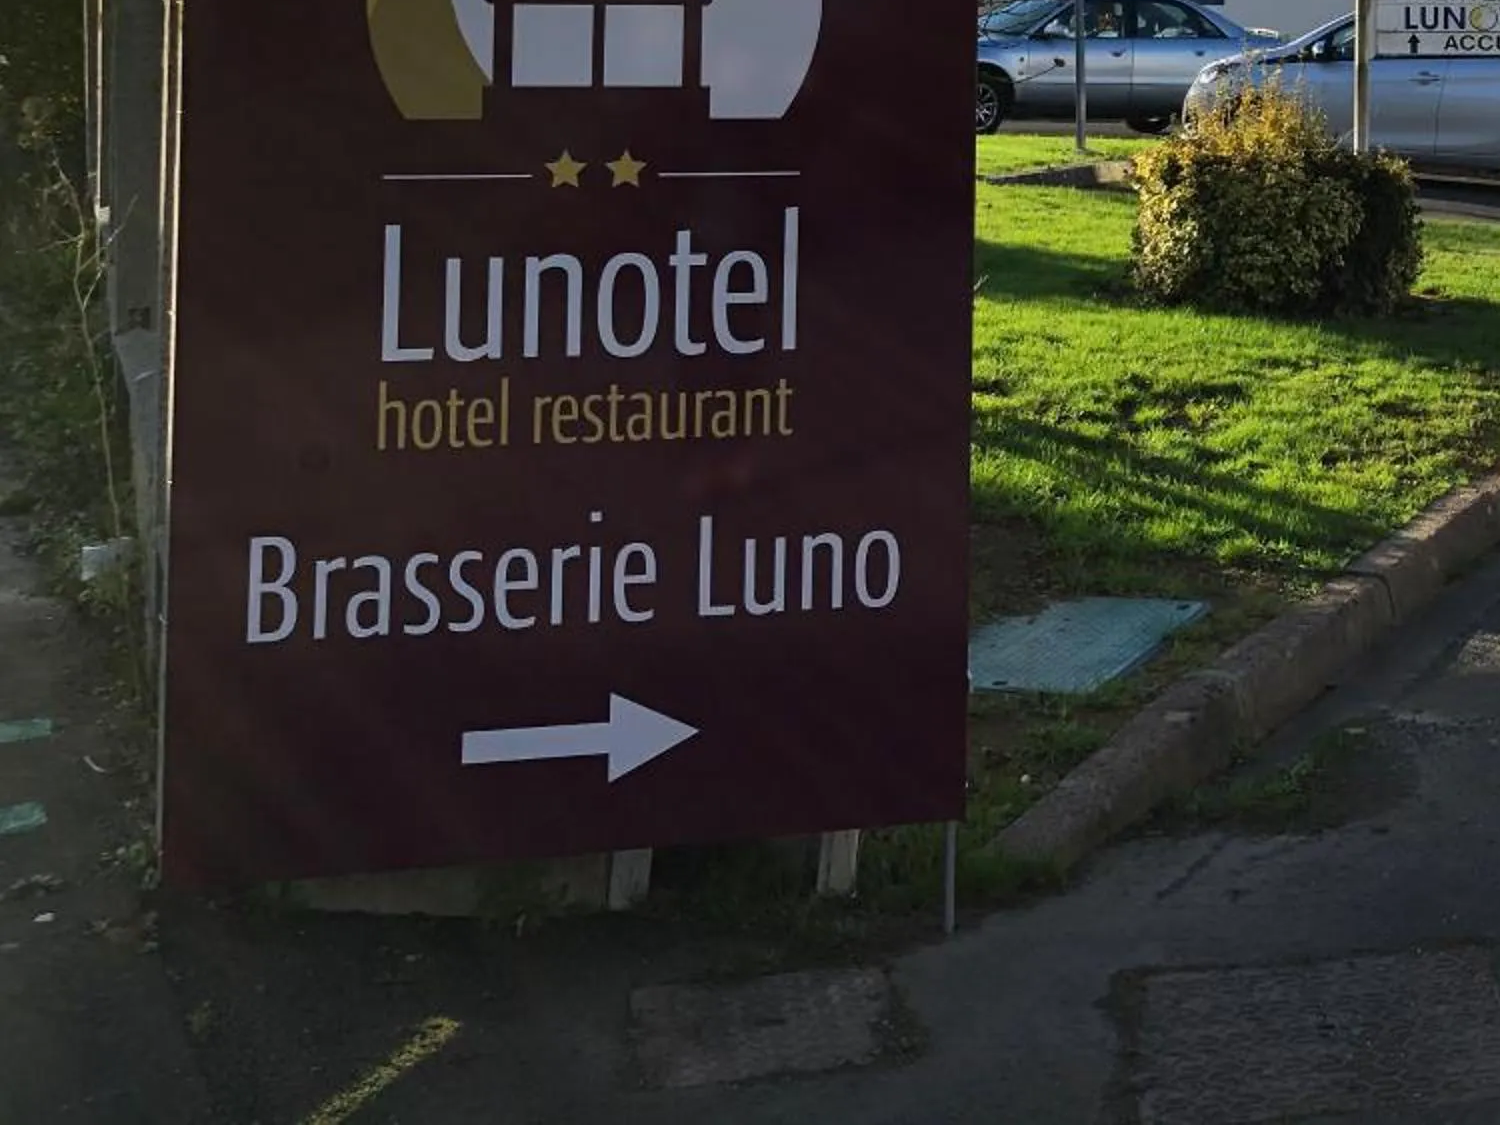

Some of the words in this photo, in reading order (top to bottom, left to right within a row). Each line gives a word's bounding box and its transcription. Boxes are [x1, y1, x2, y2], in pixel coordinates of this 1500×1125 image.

[381, 206, 799, 362] Lunotel
[377, 377, 509, 451] hotel
[533, 378, 794, 444] restaurant
[246, 511, 657, 643] Brasserie
[698, 515, 900, 617] Luno
